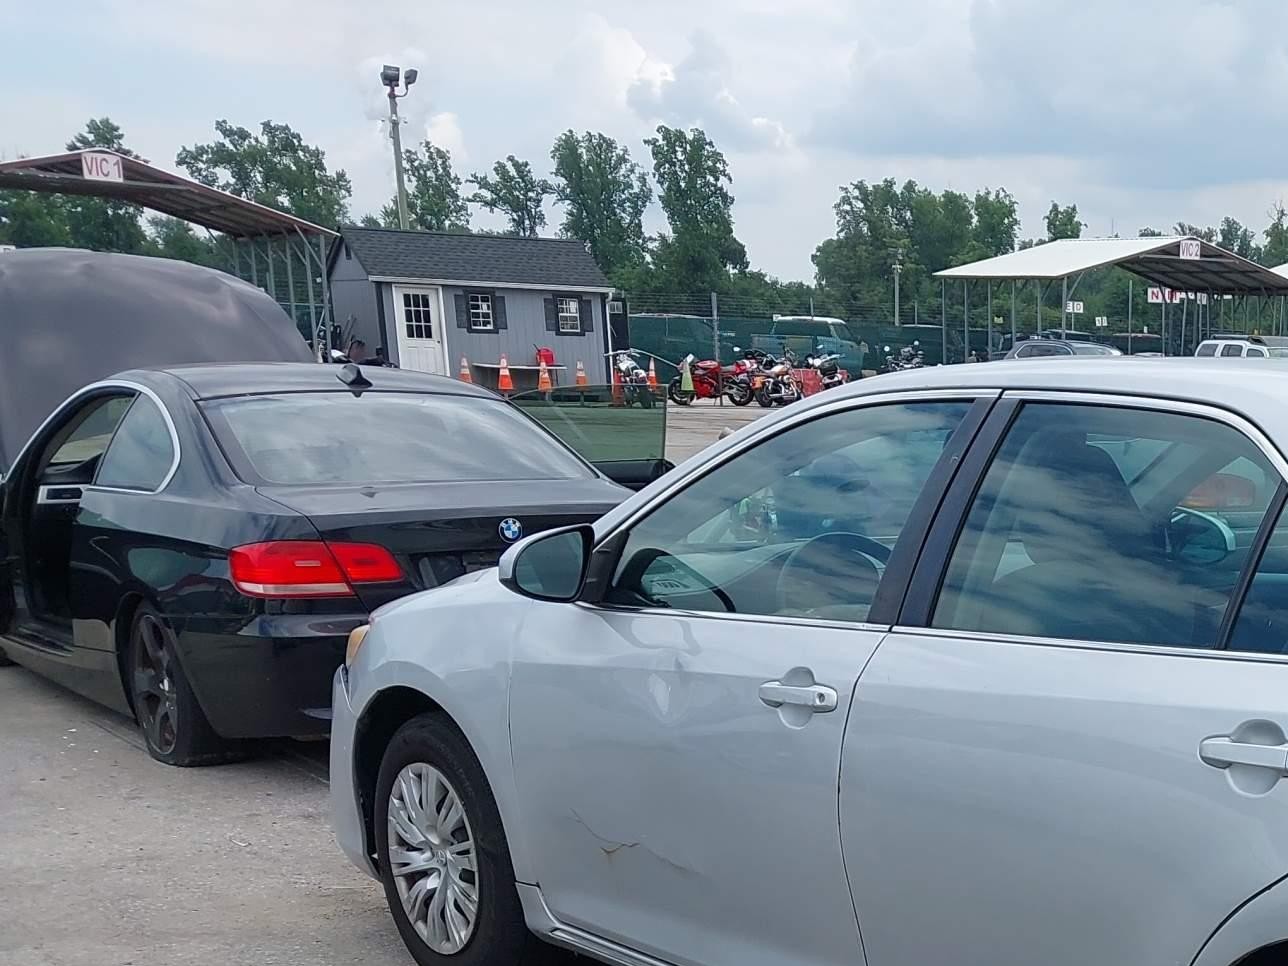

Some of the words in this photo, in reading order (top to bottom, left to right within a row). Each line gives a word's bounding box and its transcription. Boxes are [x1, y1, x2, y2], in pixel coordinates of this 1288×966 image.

[84, 156, 110, 177] VIC
[113, 159, 121, 178] 1
[1181, 242, 1193, 257] VIC
